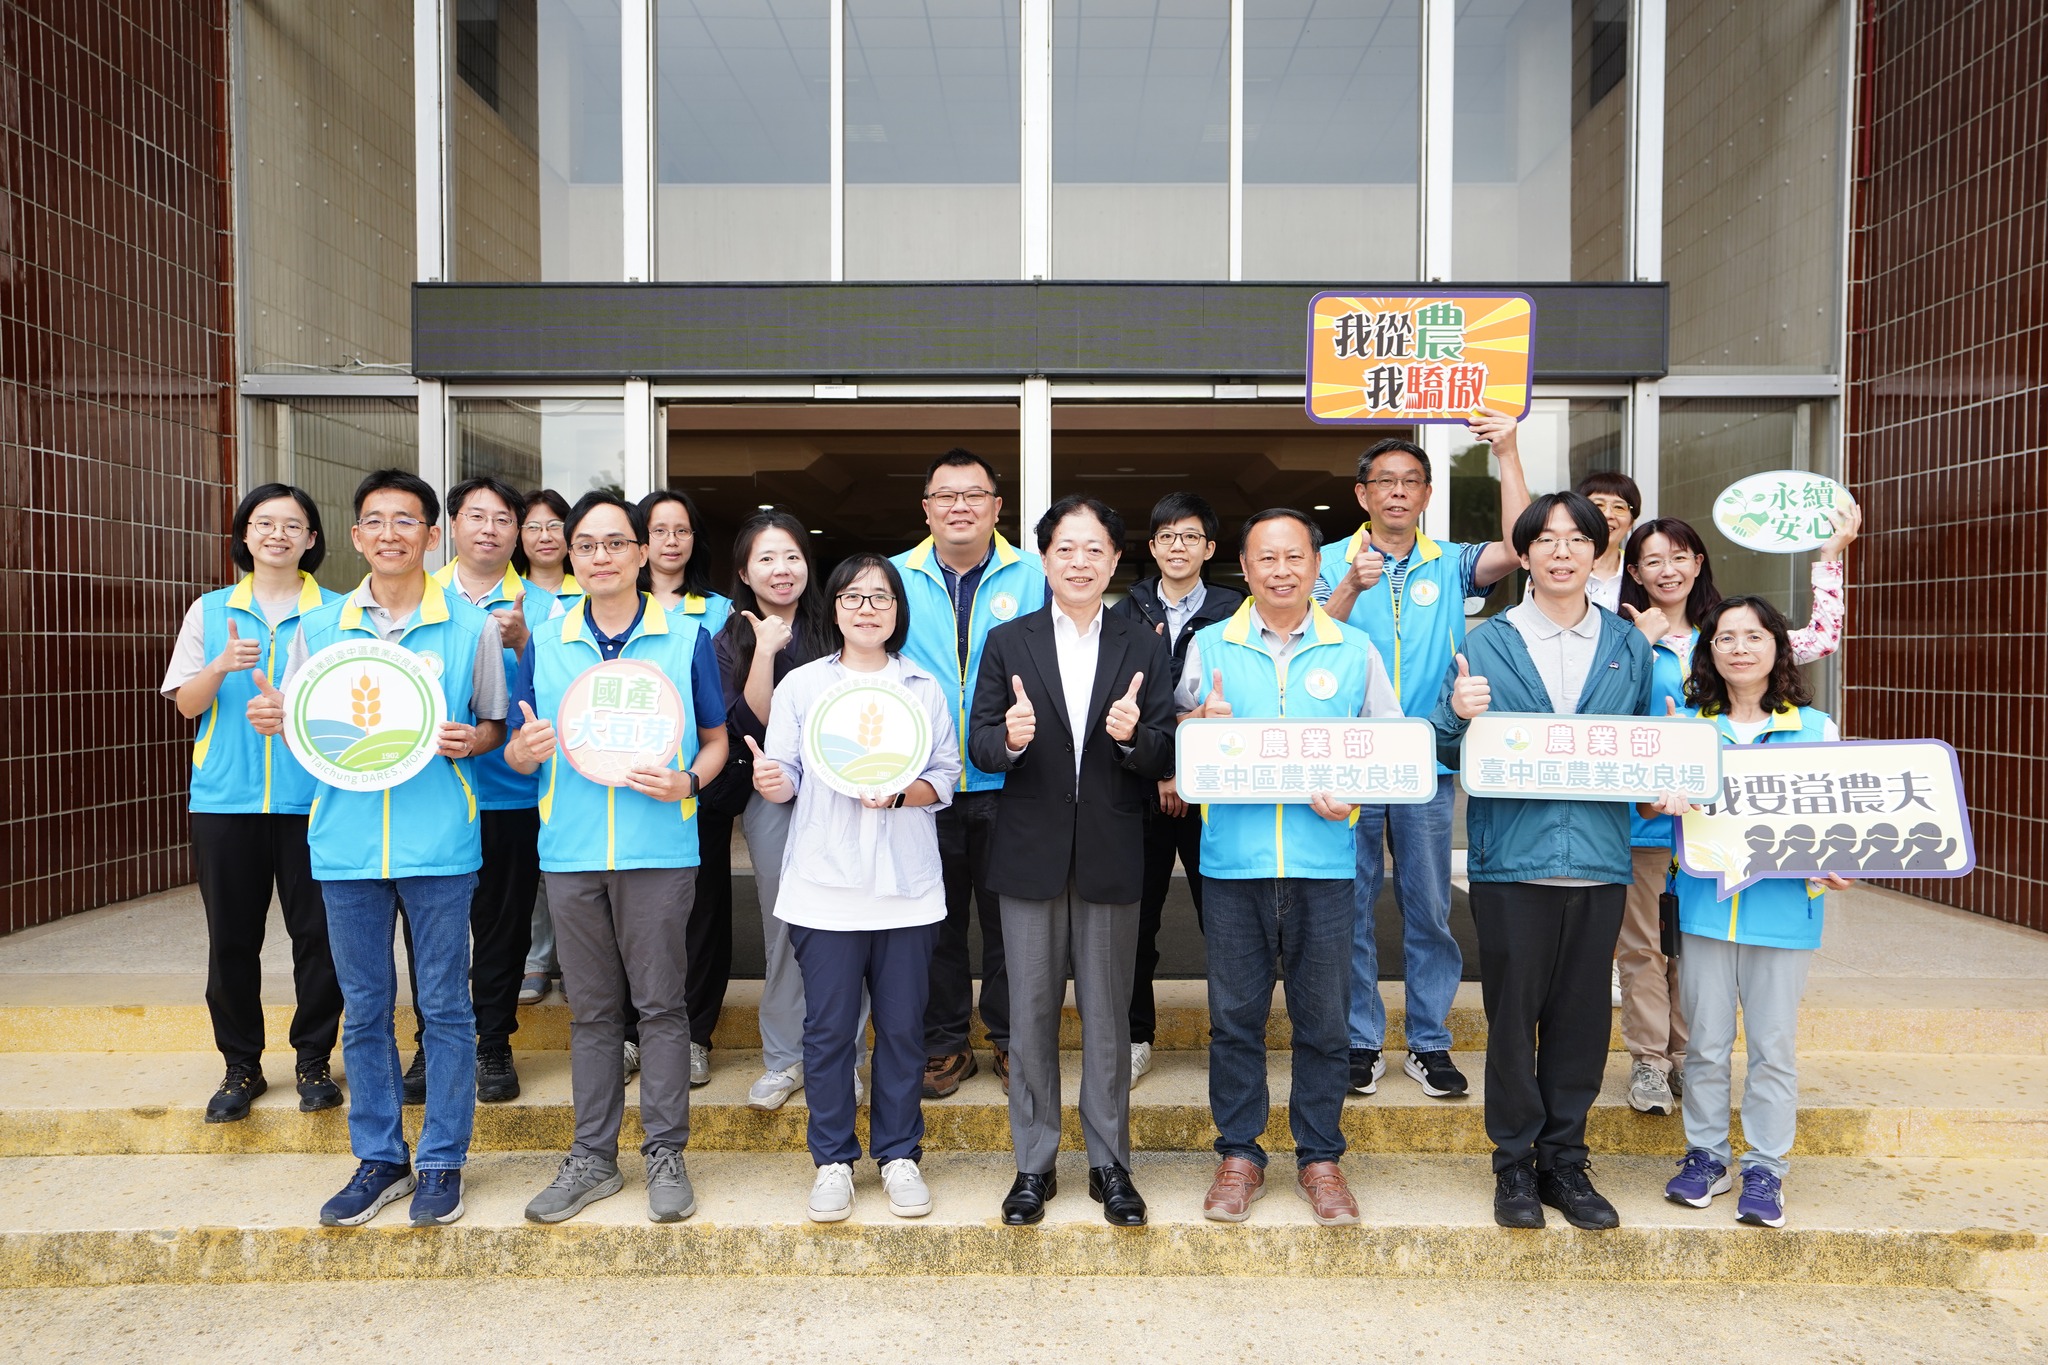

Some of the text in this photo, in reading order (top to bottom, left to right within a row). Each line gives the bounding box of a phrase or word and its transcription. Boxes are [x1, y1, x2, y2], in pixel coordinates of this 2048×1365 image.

[1335, 301, 1464, 360] 我從農
[1367, 365, 1485, 411] 我驕傲
[1768, 481, 1836, 511] 永續
[1770, 512, 1836, 542] 安心
[591, 675, 658, 711] 國產
[568, 714, 672, 751] 大豆芽
[1259, 728, 1375, 758] 農業部
[1545, 724, 1661, 757] 農業部
[310, 748, 424, 785] Taichung DARES, MOA
[381, 752, 400, 760] 1902
[818, 763, 854, 795] Taichung
[892, 772, 913, 789] MOA
[1194, 764, 1421, 793] 臺中區農業改良場
[1479, 757, 1708, 792] 臺中區農業改良場
